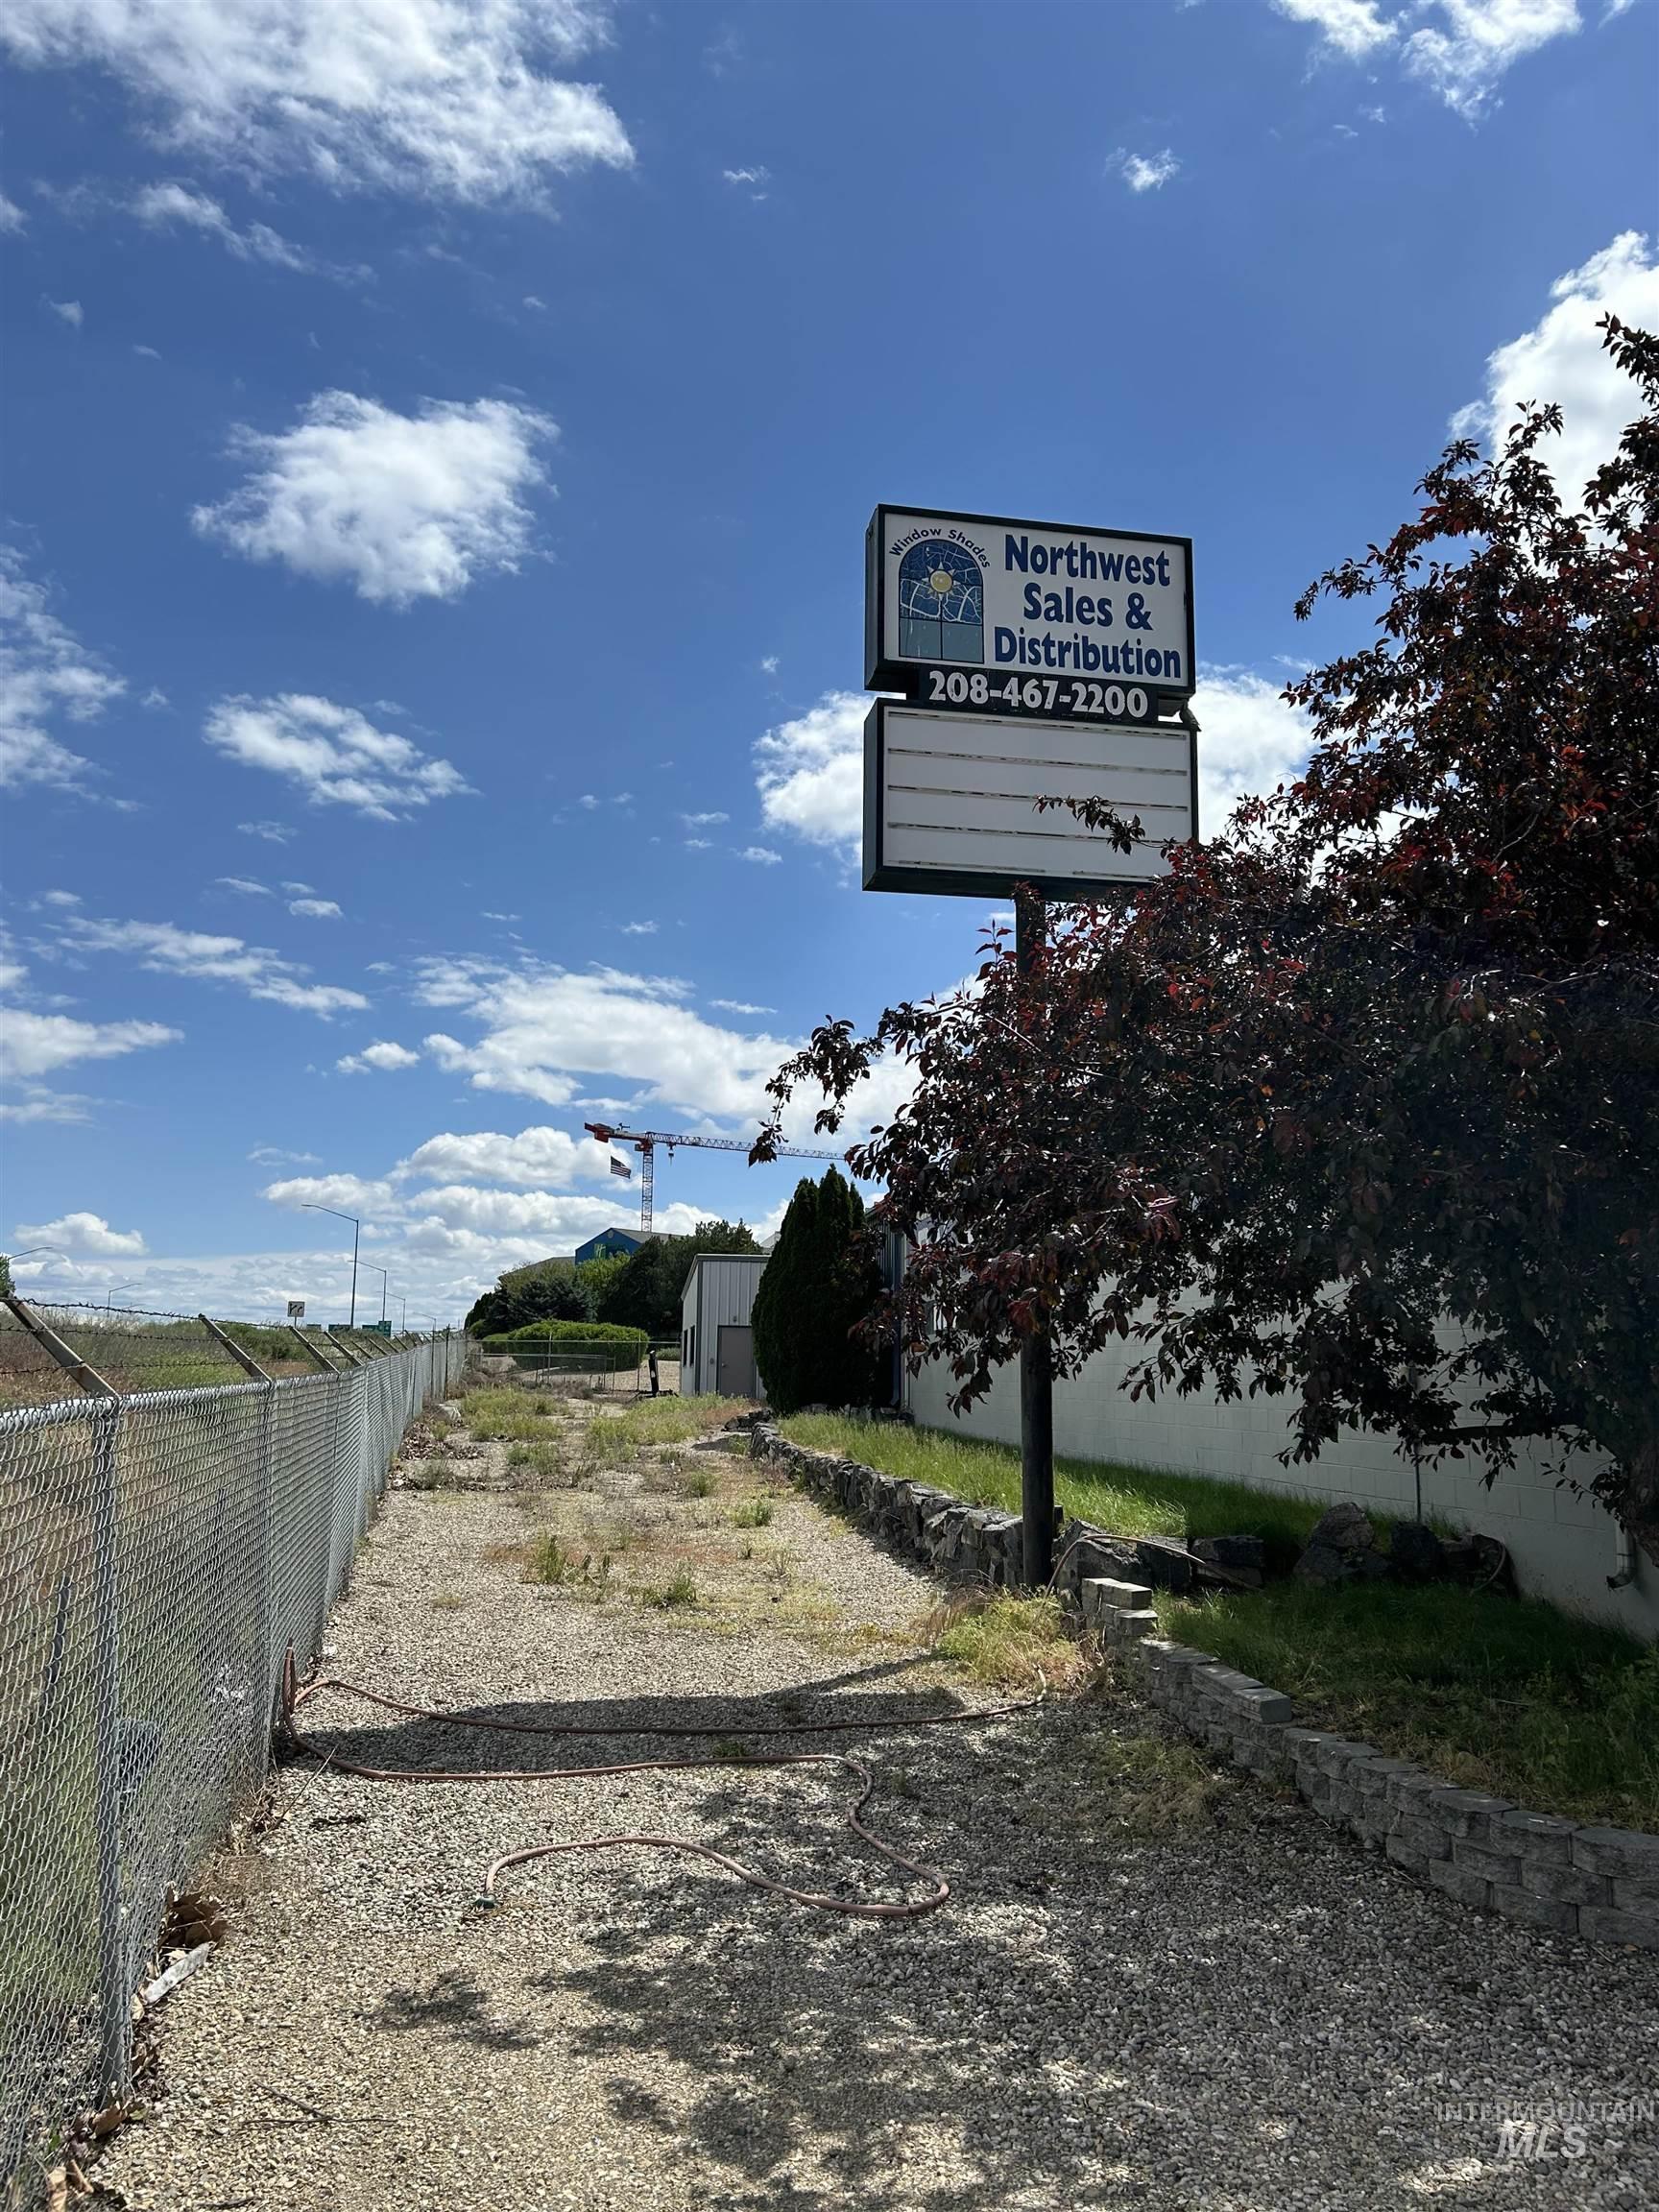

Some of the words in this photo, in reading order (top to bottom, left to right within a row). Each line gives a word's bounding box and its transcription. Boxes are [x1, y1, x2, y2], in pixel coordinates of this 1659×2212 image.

[889, 528, 942, 556] Window
[948, 529, 990, 568] Shades
[1005, 534, 1170, 587] Northwest
[1023, 582, 1113, 627] Sales
[1125, 592, 1153, 630] &
[994, 626, 1181, 678] Distribution
[928, 671, 1148, 717] 208-467-2200
